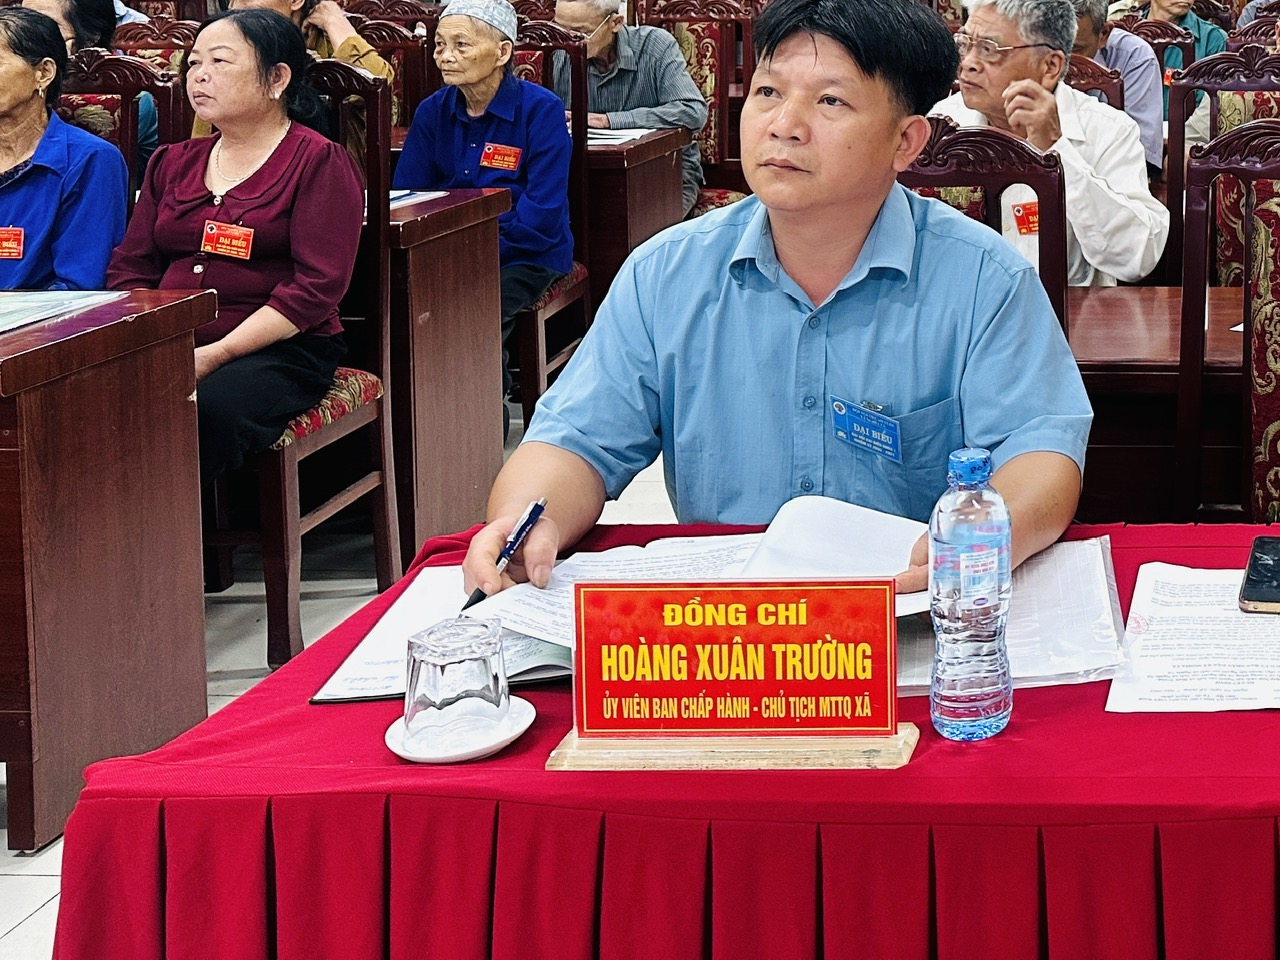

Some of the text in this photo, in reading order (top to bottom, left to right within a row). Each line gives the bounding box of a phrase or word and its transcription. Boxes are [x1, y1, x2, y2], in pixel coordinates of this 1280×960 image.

[853, 422, 870, 436] ĐẠI
[872, 430, 893, 444] BIỂU
[663, 597, 808, 626] ĐỒNG CHÍ
[601, 634, 872, 681] HOÀNG XUÂN TRƯỜNG
[603, 690, 619, 719] ỦY
[622, 693, 650, 719] VIÊN
[653, 697, 678, 719] BAN
[681, 689, 713, 719] CHẤP
[717, 692, 749, 719] HÀNH
[761, 690, 786, 718] CHỦ
[789, 696, 816, 722] TỊCH
[819, 696, 852, 720] MTTQ
[855, 692, 871, 717] XÃ
